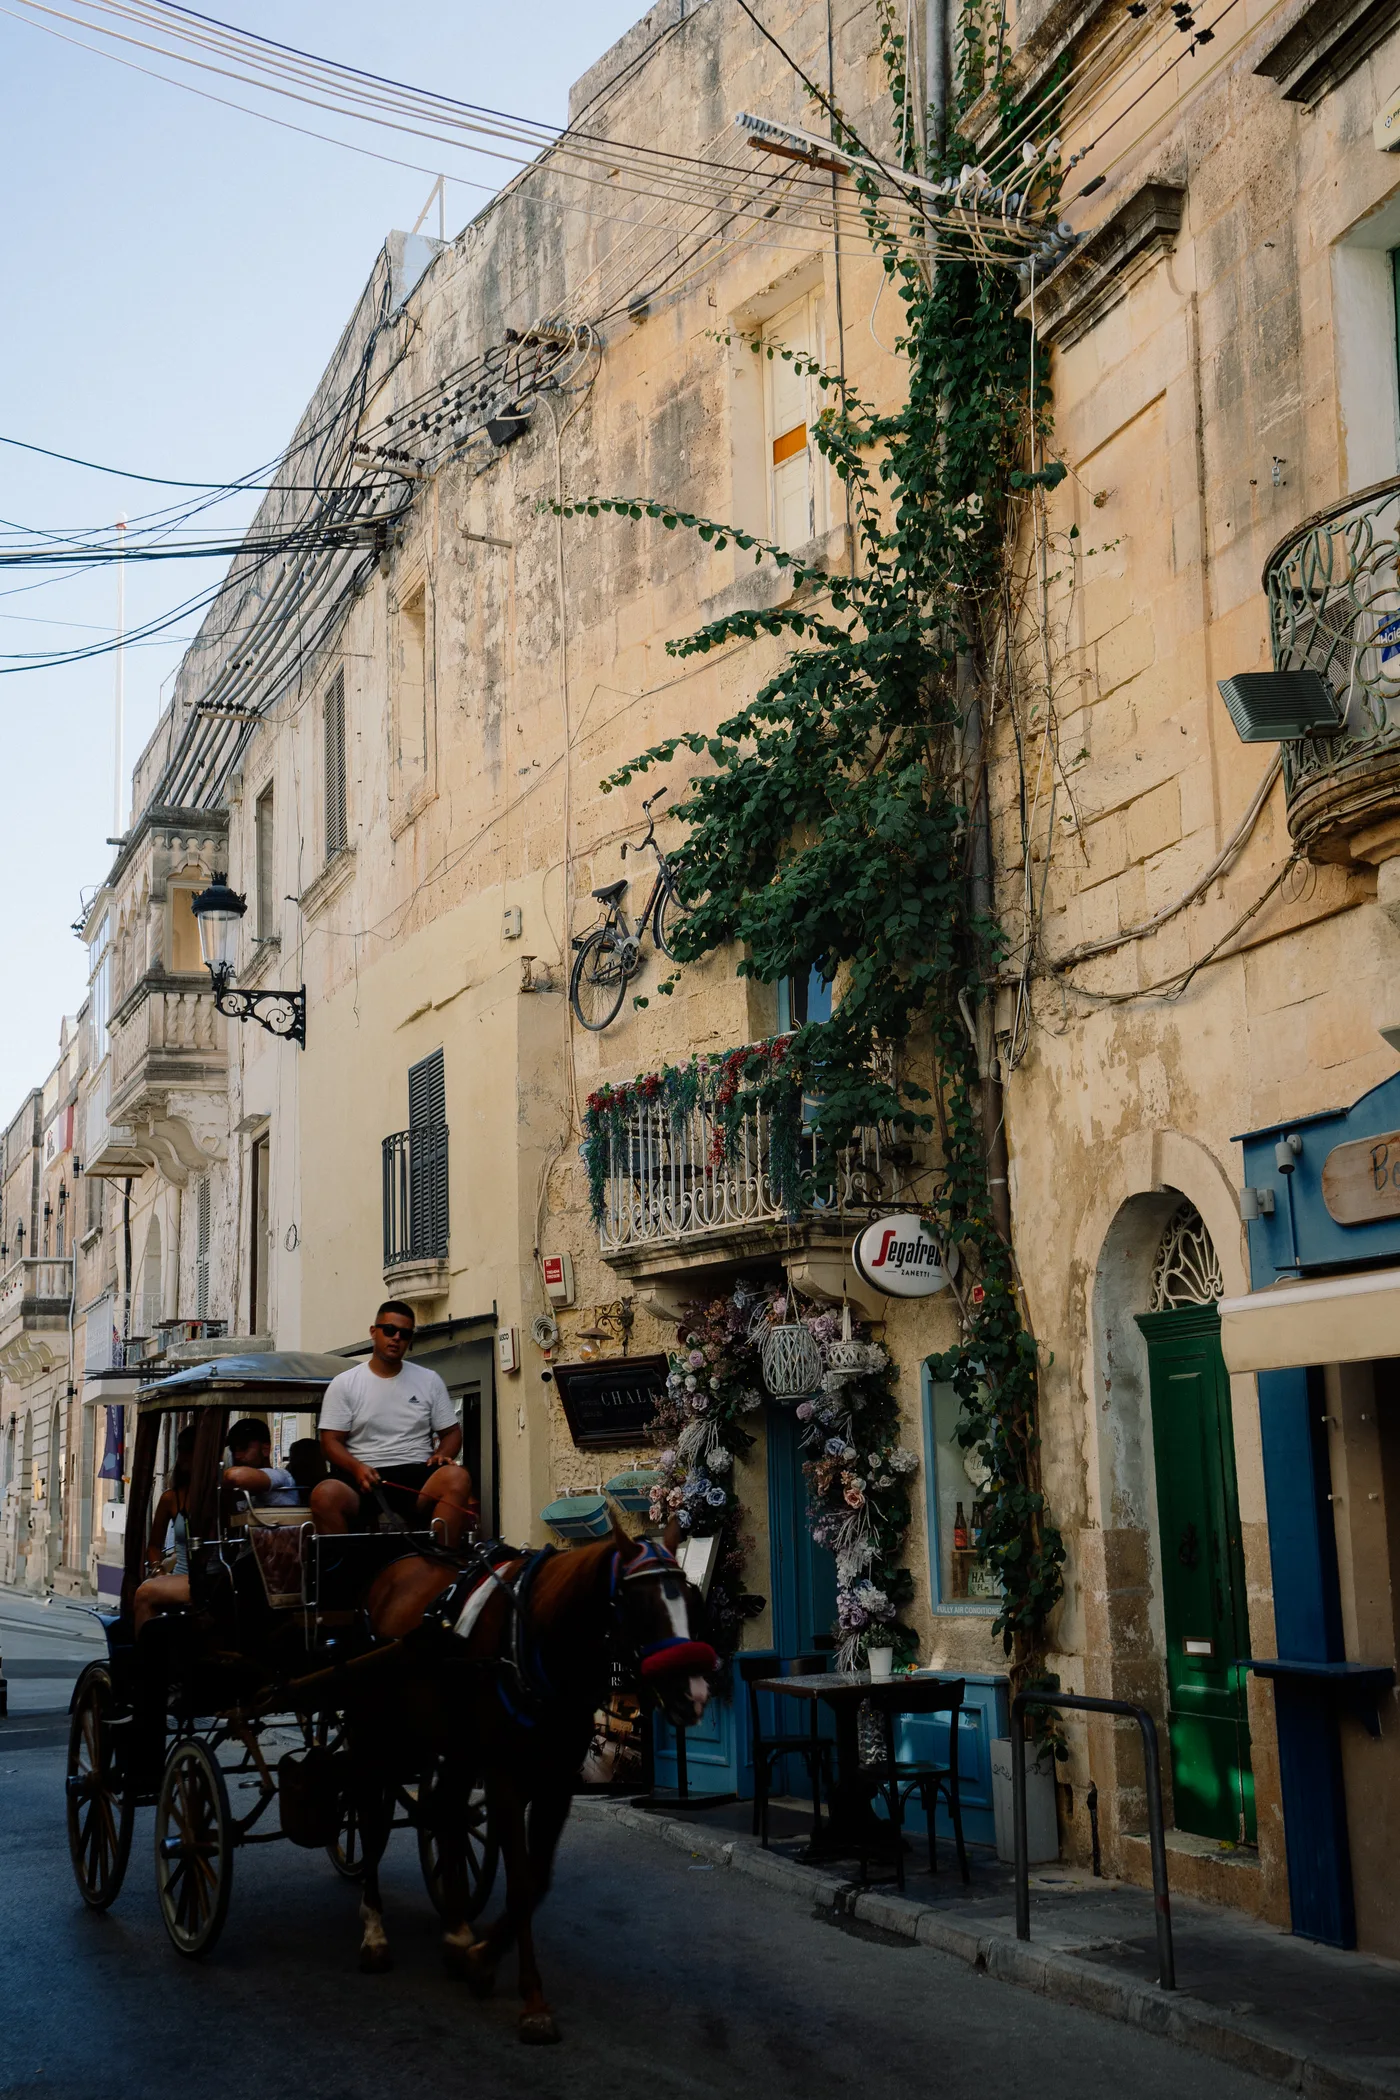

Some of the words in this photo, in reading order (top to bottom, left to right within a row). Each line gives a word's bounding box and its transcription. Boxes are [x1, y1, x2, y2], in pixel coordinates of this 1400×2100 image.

[871, 1230, 944, 1268] Segafred
[901, 1269, 930, 1278] ZANETTI
[937, 1606, 954, 1614] FULLY
[954, 1606, 964, 1614] AIR
